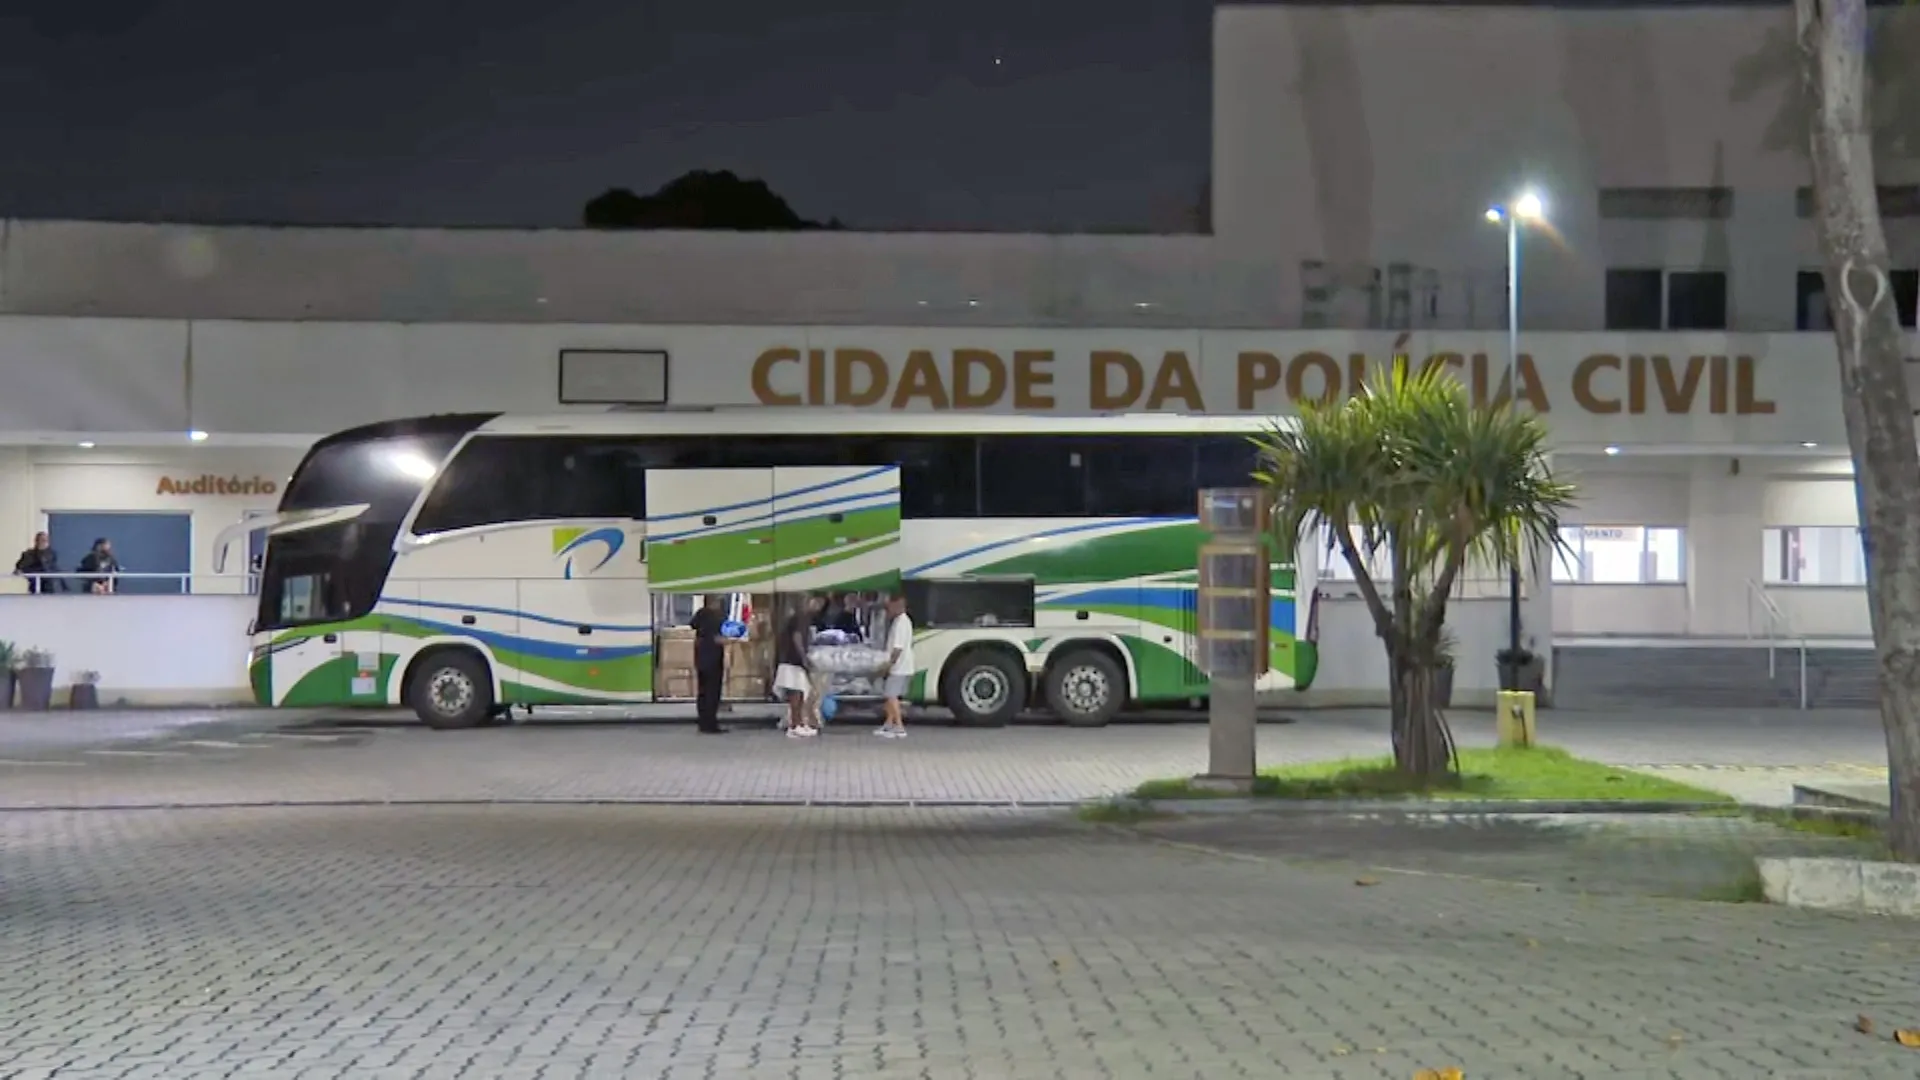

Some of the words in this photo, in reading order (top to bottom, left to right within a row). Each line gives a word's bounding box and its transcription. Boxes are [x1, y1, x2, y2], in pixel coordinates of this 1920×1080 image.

[751, 347, 1055, 410] CIDADE
[1090, 350, 1205, 411] DA
[1571, 354, 1776, 414] CIVIL
[156, 474, 277, 495] Auditório
